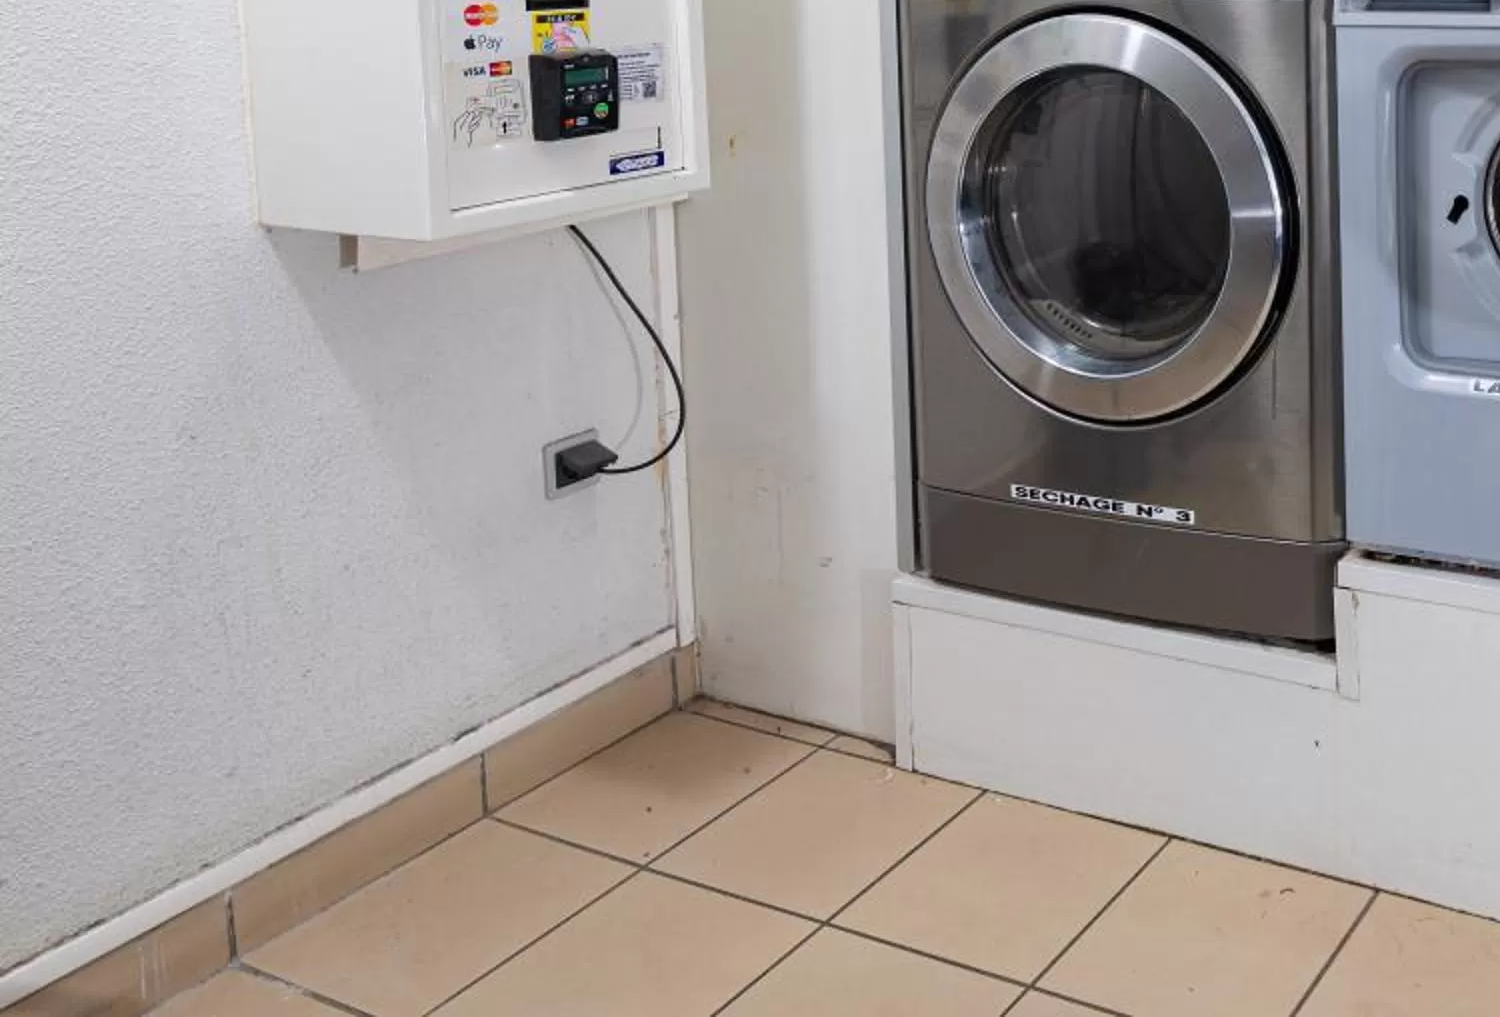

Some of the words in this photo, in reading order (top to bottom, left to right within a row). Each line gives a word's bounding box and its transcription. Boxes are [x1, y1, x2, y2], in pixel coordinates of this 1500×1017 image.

[478, 34, 503, 53] Pay
[463, 66, 486, 77] VISA
[1015, 486, 1126, 514] SECHAGE
[1175, 510, 1191, 522] 3
